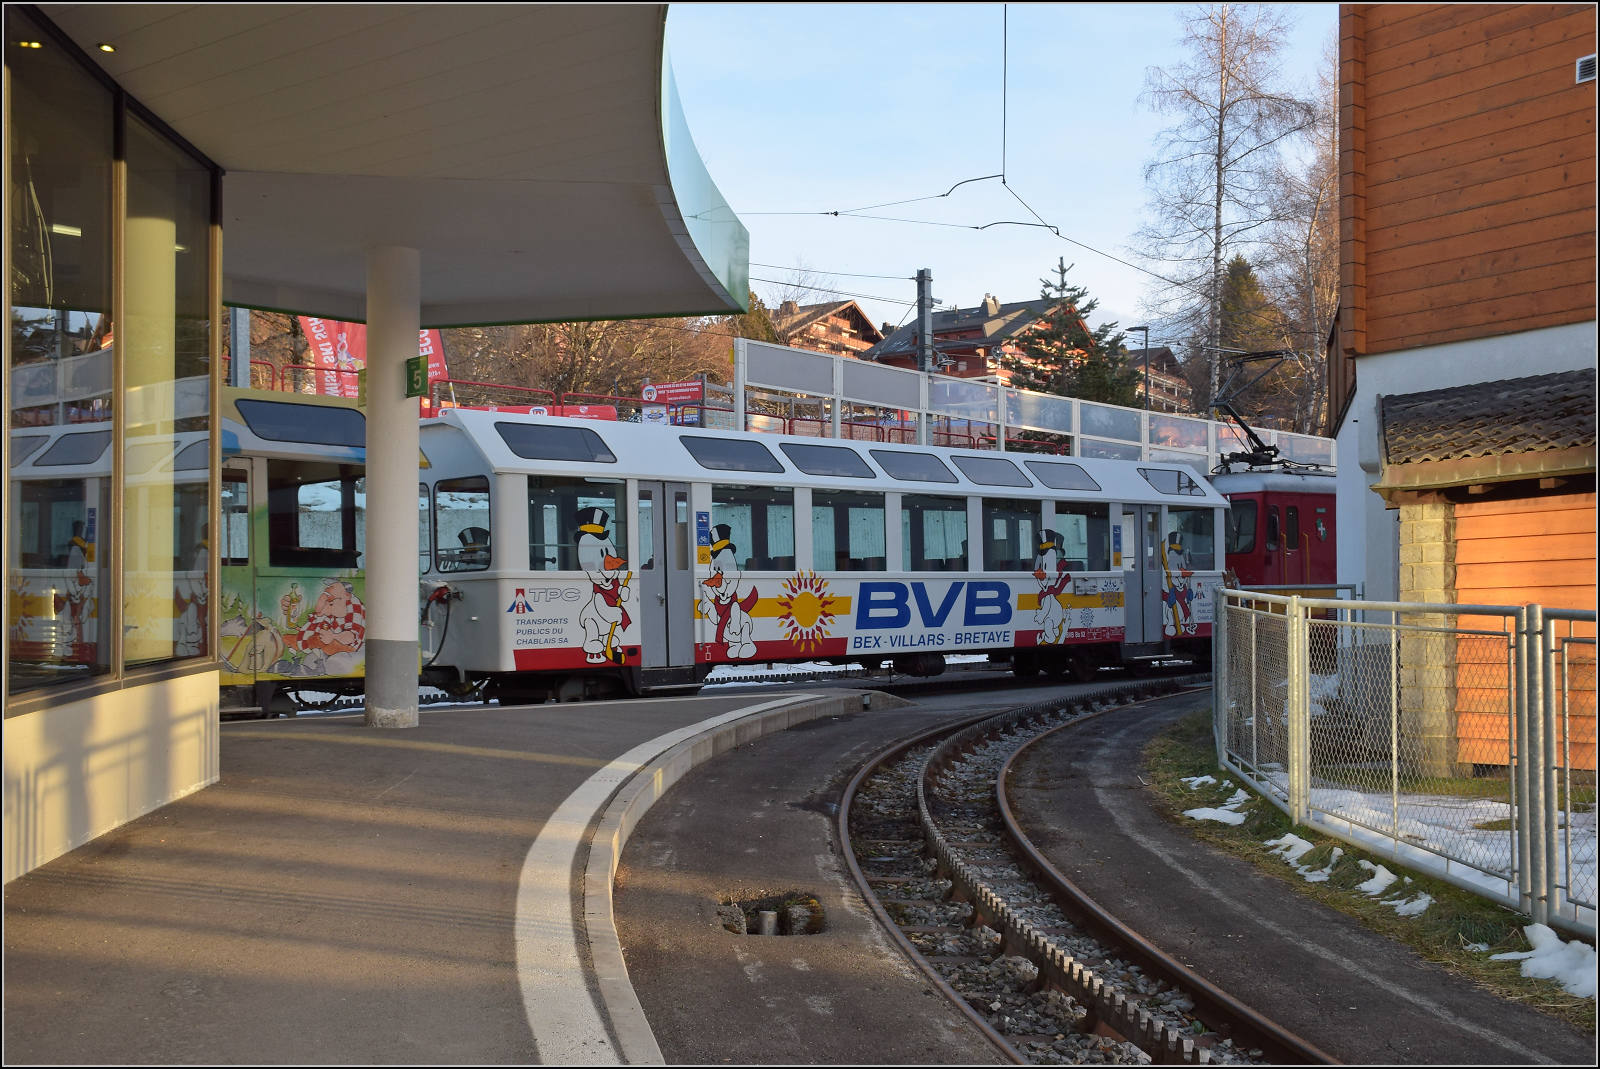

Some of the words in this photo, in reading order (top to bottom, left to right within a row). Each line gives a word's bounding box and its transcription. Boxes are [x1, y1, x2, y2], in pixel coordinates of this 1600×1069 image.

[413, 369, 422, 390] 5
[528, 588, 581, 603] TPC
[855, 581, 1013, 630] BVB
[853, 636, 882, 649] BEX
[889, 633, 945, 648] VILLARS
[954, 630, 1011, 645] BRETAYE
